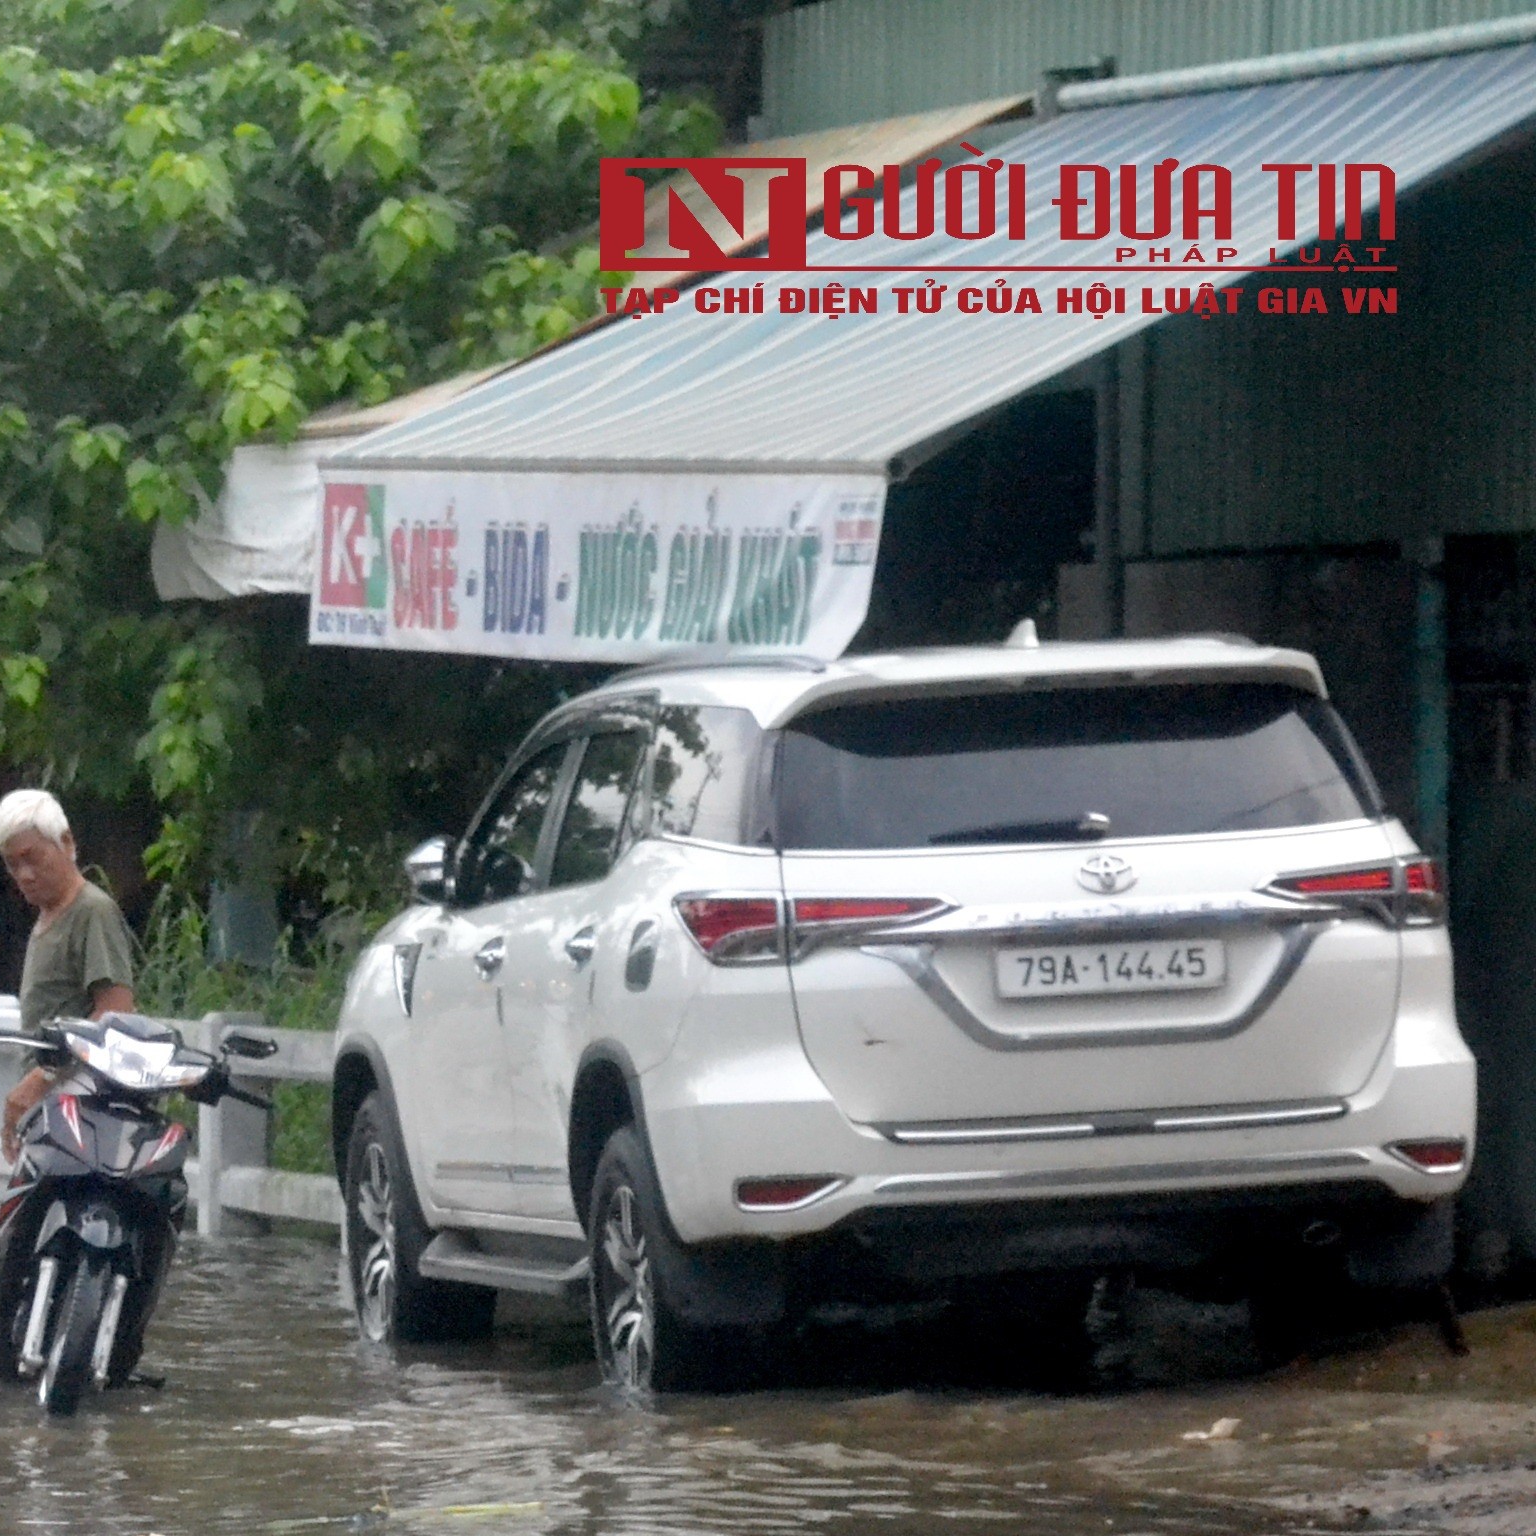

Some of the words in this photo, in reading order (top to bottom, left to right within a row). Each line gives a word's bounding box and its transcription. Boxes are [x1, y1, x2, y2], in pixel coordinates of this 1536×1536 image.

[483, 520, 550, 636] BIDA
[574, 500, 659, 641] NƯỚC
[659, 487, 732, 644] GIẢI
[727, 502, 823, 647] KHÁT
[1015, 947, 1207, 988] 79A-144.45
